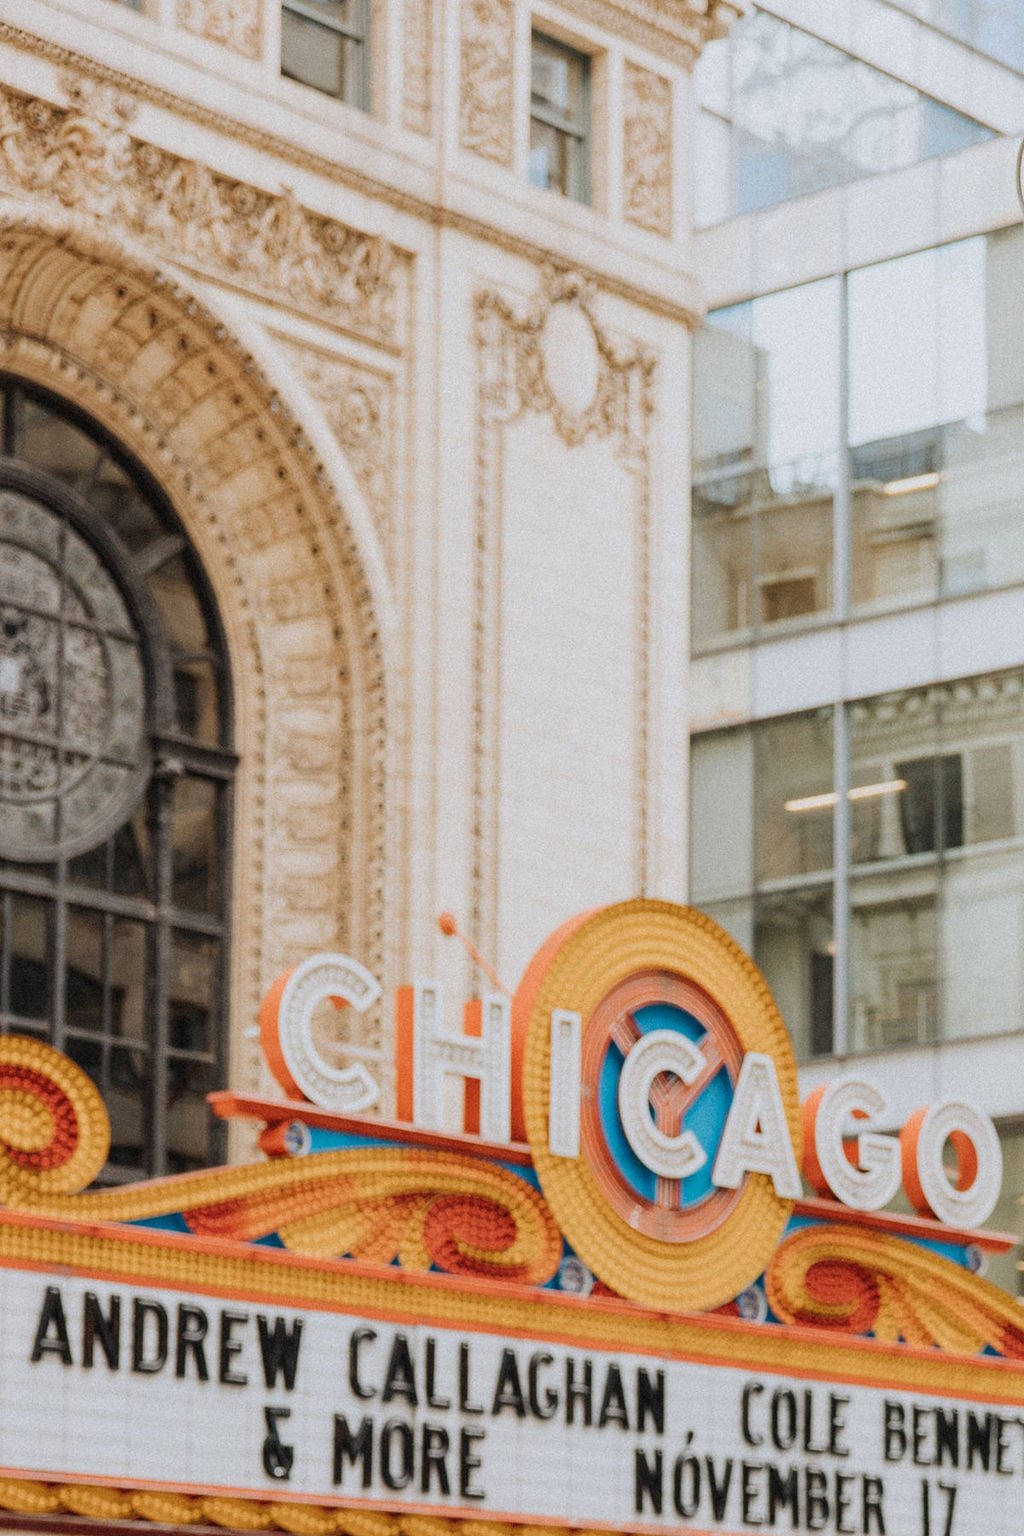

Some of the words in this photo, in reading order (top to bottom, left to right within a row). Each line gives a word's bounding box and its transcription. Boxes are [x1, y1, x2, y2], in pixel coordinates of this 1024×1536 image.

[263, 953, 1003, 1230] CHICAGO
[31, 1286, 305, 1391] ANDREW
[741, 1381, 850, 1456] COLE
[262, 1406, 294, 1480] &
[333, 1414, 485, 1499] MORE
[634, 1448, 886, 1536] NOVEMBER
